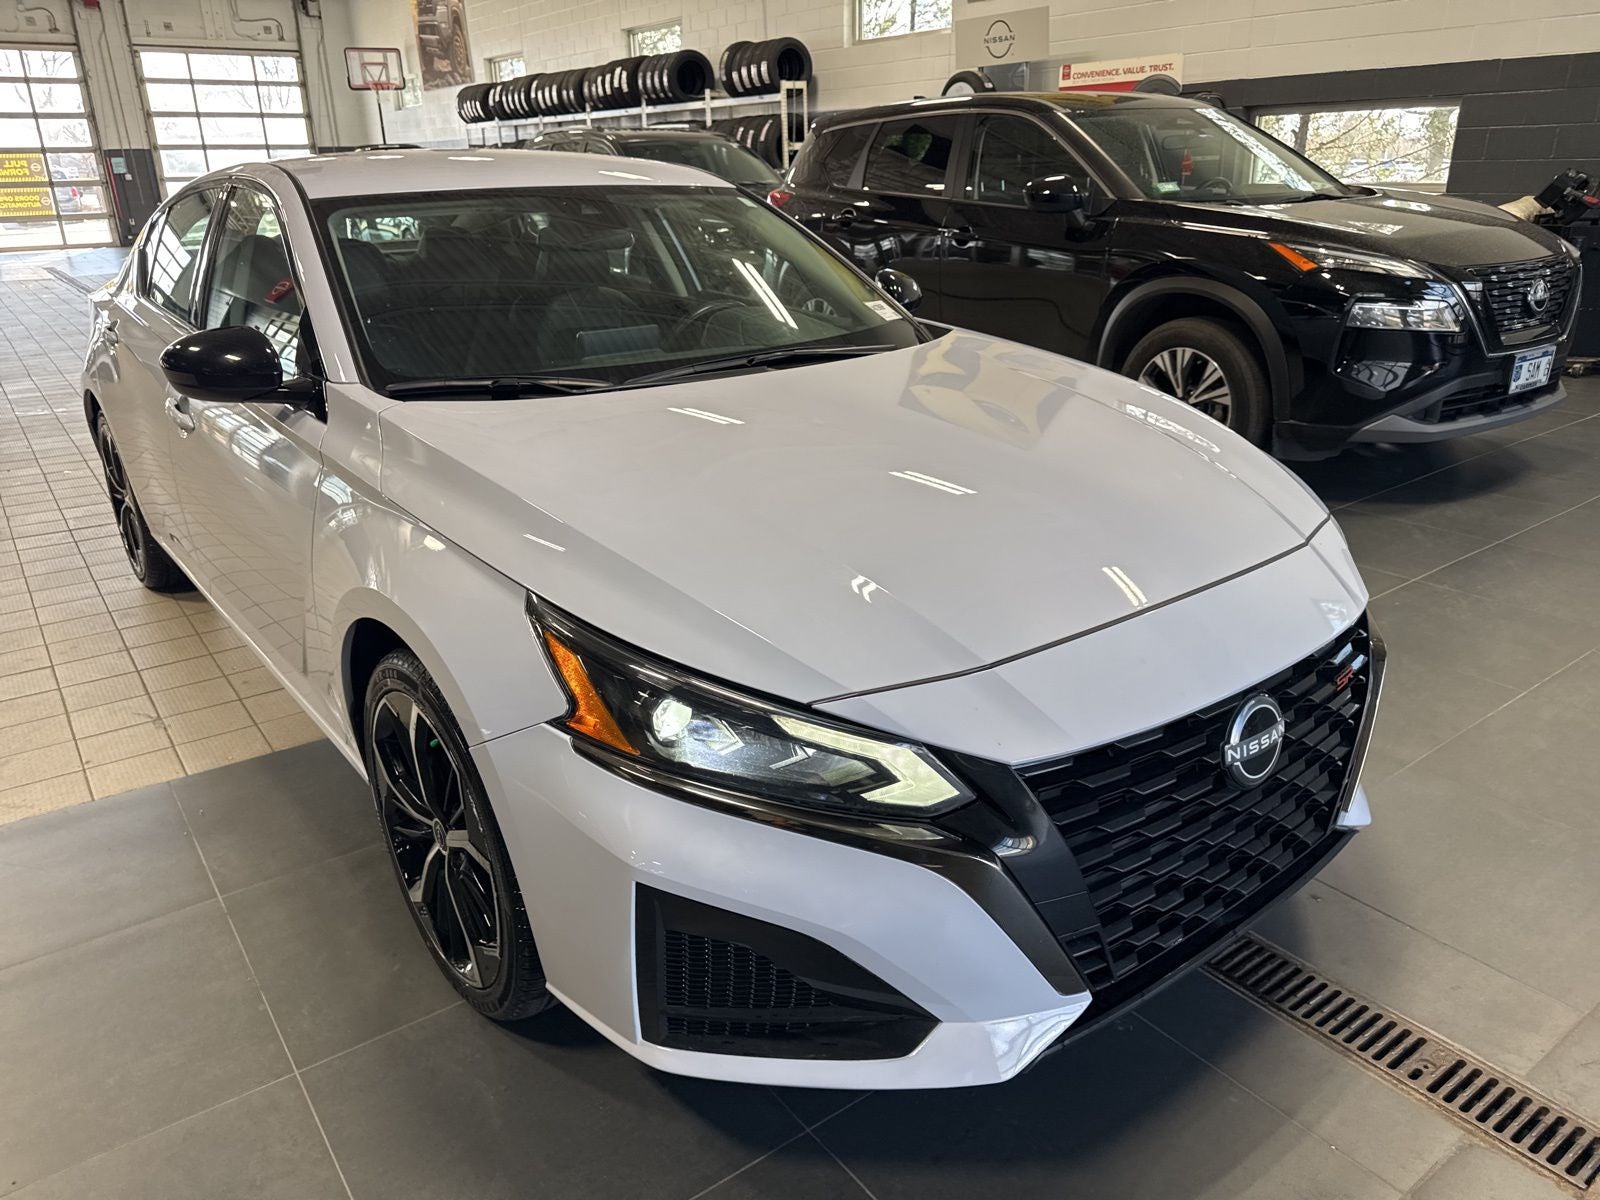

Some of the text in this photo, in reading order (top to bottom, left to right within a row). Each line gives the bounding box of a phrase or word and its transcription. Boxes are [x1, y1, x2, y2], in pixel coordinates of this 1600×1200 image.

[984, 34, 1016, 44] NISSAN
[1072, 68, 1121, 80] CONVENIENCE.
[1149, 63, 1175, 73] TRUST.
[1335, 667, 1354, 691] SR
[1227, 725, 1285, 761] NISSAN
